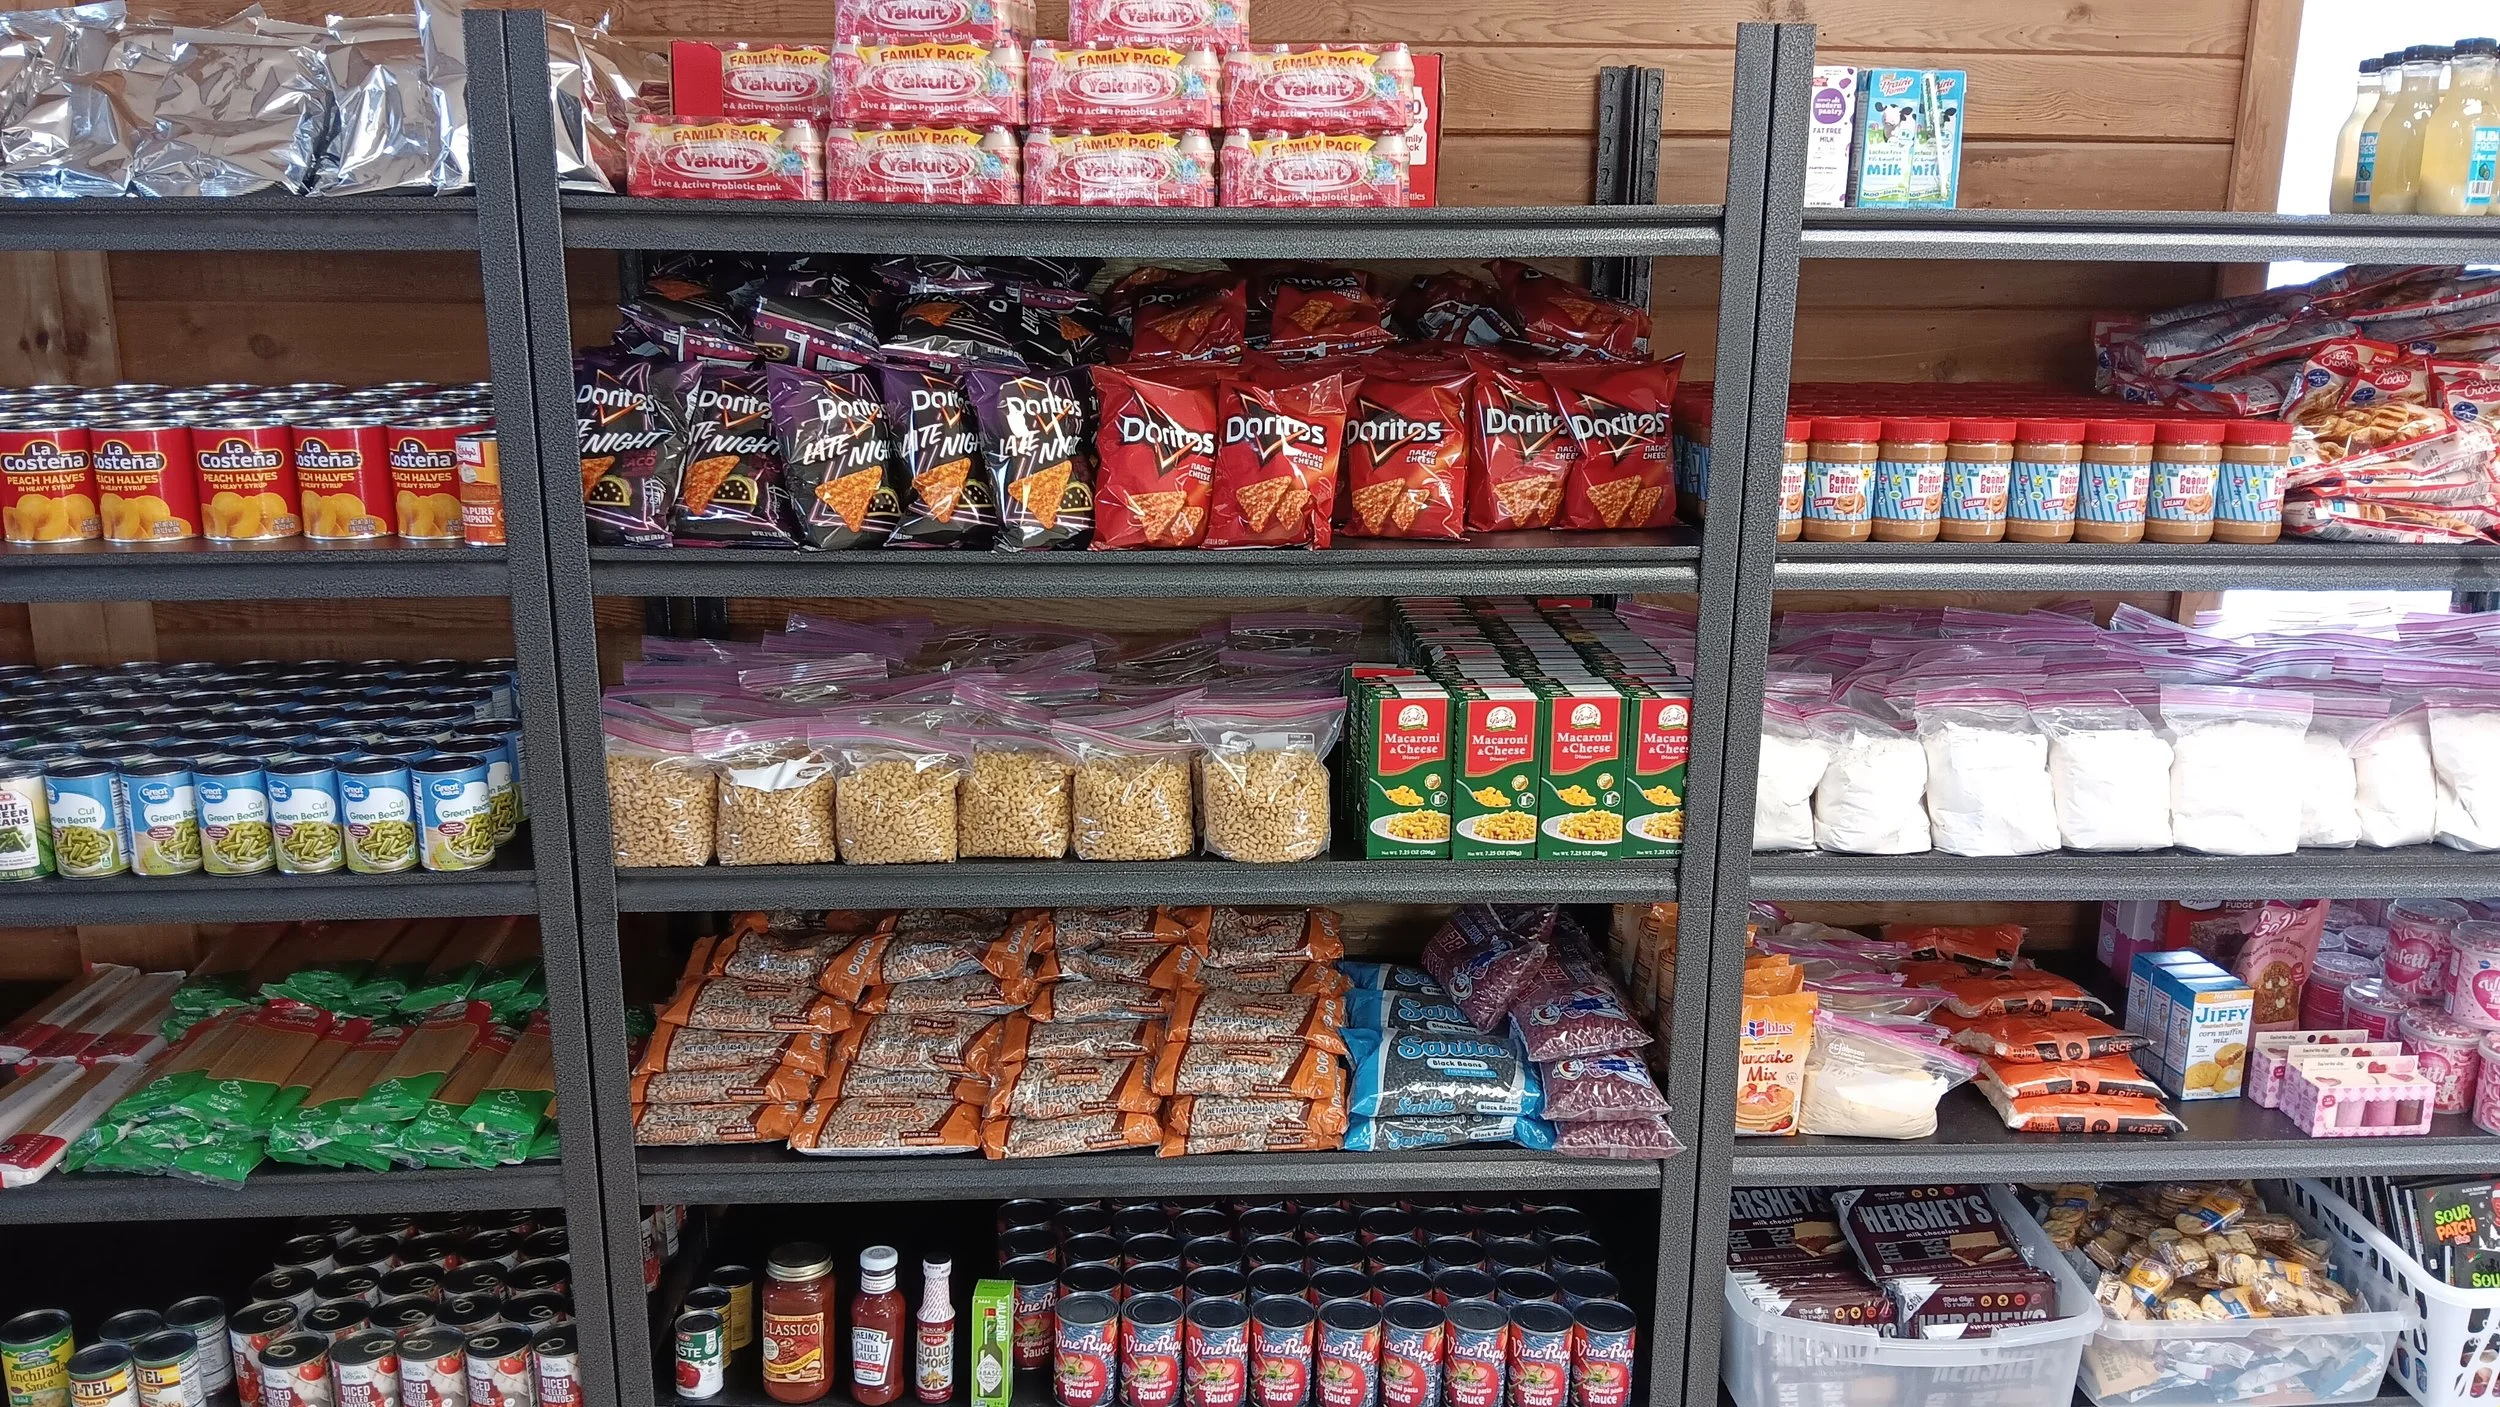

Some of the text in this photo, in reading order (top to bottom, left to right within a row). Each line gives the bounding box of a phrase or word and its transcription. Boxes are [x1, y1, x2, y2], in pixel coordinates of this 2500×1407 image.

[884, 4, 948, 20] Yakult
[729, 53, 818, 66] FAMILY PACK
[880, 48, 975, 62] FAMILY PACK
[1077, 52, 1171, 66] FAMILY PACK
[737, 76, 805, 92] Yakult
[893, 74, 962, 90] Yakult
[673, 128, 769, 142] FAMILY PACK
[876, 132, 969, 146] FAMILY PACK
[1271, 140, 1362, 155] FAMILY PACK
[682, 152, 752, 169] Yakult
[887, 158, 956, 173] Yakult
[1866, 163, 1902, 176] Milk
[653, 180, 672, 188] Live
[682, 181, 711, 189] Active
[711, 181, 755, 191] Probiotic
[757, 183, 782, 192] Drink
[2375, 370, 2411, 386] Crocker
[577, 384, 655, 412] Doritos
[1226, 413, 1325, 446] Doritos
[1347, 418, 1442, 444] Doritos
[1572, 411, 1665, 440] Doritos
[582, 429, 672, 453] NIGHT
[1122, 416, 1215, 454] Doritos
[31, 444, 51, 456] La
[107, 444, 123, 455] La
[225, 442, 244, 454] La
[305, 442, 320, 453] La
[403, 442, 418, 453] La
[803, 435, 851, 465] LATE
[1408, 449, 1438, 458] NACHO
[3, 455, 84, 471] Costeña
[200, 453, 277, 469] Costeña
[1292, 456, 1324, 470] CHEESE
[1405, 455, 1437, 465] CHEESE
[1190, 462, 1212, 474] NACHO
[7, 473, 86, 485] PEACH HALVES
[116, 474, 159, 484] HALVES
[203, 472, 278, 483] PEACH HALVES
[315, 472, 354, 482] HALVES
[411, 472, 452, 482] HALVES
[1188, 470, 1212, 482] CHEESE
[1828, 473, 1860, 485] Peanut
[1980, 473, 2006, 486] Peanut
[2180, 475, 2210, 486] Peanut
[26, 485, 50, 493] HEAVY
[51, 483, 76, 491] SYRUP
[1828, 483, 1859, 494] Butter
[1980, 483, 2005, 494] Butter
[2180, 484, 2208, 495] Butter
[1902, 499, 1923, 509] CREAMY
[471, 506, 495, 516] PURE
[1384, 733, 1441, 743] Macaroni
[1472, 735, 1529, 745] Macaroni
[1556, 732, 1613, 742] Macaroni
[1643, 733, 1688, 743] Macaro
[142, 787, 168, 798] Great
[200, 786, 222, 797] Great
[78, 806, 95, 816] Cut
[248, 801, 263, 810] Cut
[312, 802, 328, 811] Cut
[389, 800, 404, 810] Cut
[67, 815, 97, 824] Beans
[151, 813, 176, 823] Green
[207, 809, 265, 822] Green Beans
[275, 810, 329, 821] Green Beans
[350, 809, 405, 821] Green Beans
[2225, 901, 2254, 909] FUDGE
[2195, 1007, 2250, 1023] JIFFY
[270, 1016, 318, 1028] Spaghetti
[1767, 1022, 1793, 1034] blas
[2198, 1027, 2243, 1038] corn muffin
[1397, 1035, 1510, 1060] Sarita
[2108, 1042, 2133, 1053] RICE
[1747, 1066, 1778, 1082] Mix
[663, 1085, 711, 1101] Sarita
[1394, 1097, 1457, 1115] Sarita
[836, 1130, 883, 1145] Sarita
[1388, 1130, 1449, 1149] Sarita
[1858, 1194, 1993, 1233] HERSHEY'S
[2434, 1203, 2473, 1226] SOUR
[1752, 1216, 1804, 1227] milk chocolate
[1923, 1228, 1960, 1238] chocolate
[2435, 1217, 2477, 1242] PATCH
[996, 1300, 1007, 1342] JALAPEÑO
[765, 1322, 819, 1335] CLASSICO
[855, 1330, 879, 1343] HEINZ
[923, 1336, 944, 1345] Colgin
[1123, 1331, 1157, 1353] Vine
[1254, 1332, 1289, 1353] Vine
[855, 1342, 879, 1353] CHILI
[917, 1345, 950, 1356] LIQUID
[1190, 1335, 1224, 1356] Vine
[1342, 1340, 1374, 1362] Ripe
[1402, 1340, 1435, 1362] Ripe
[1511, 1336, 1545, 1358] Vine
[1575, 1335, 1608, 1358] Vine
[855, 1351, 881, 1362] SAUCE
[917, 1356, 950, 1368] SMOKE
[10, 1363, 68, 1383] Enchilada
[342, 1384, 370, 1397] DICED
[542, 1378, 571, 1390] DICED
[1082, 1380, 1100, 1389] pasta
[544, 1388, 568, 1396] PEELED
[1064, 1384, 1092, 1399] Sauce
[1137, 1384, 1166, 1400] Sauce
[1204, 1389, 1234, 1403] Sauce
[1265, 1386, 1294, 1401] Sauce
[1385, 1388, 1411, 1404] Sauce
[1456, 1388, 1485, 1404] Sauce
[1587, 1391, 1617, 1405] Sauce
[540, 1394, 575, 1404] TOMATOES
[1523, 1391, 1552, 1406] Sauce
